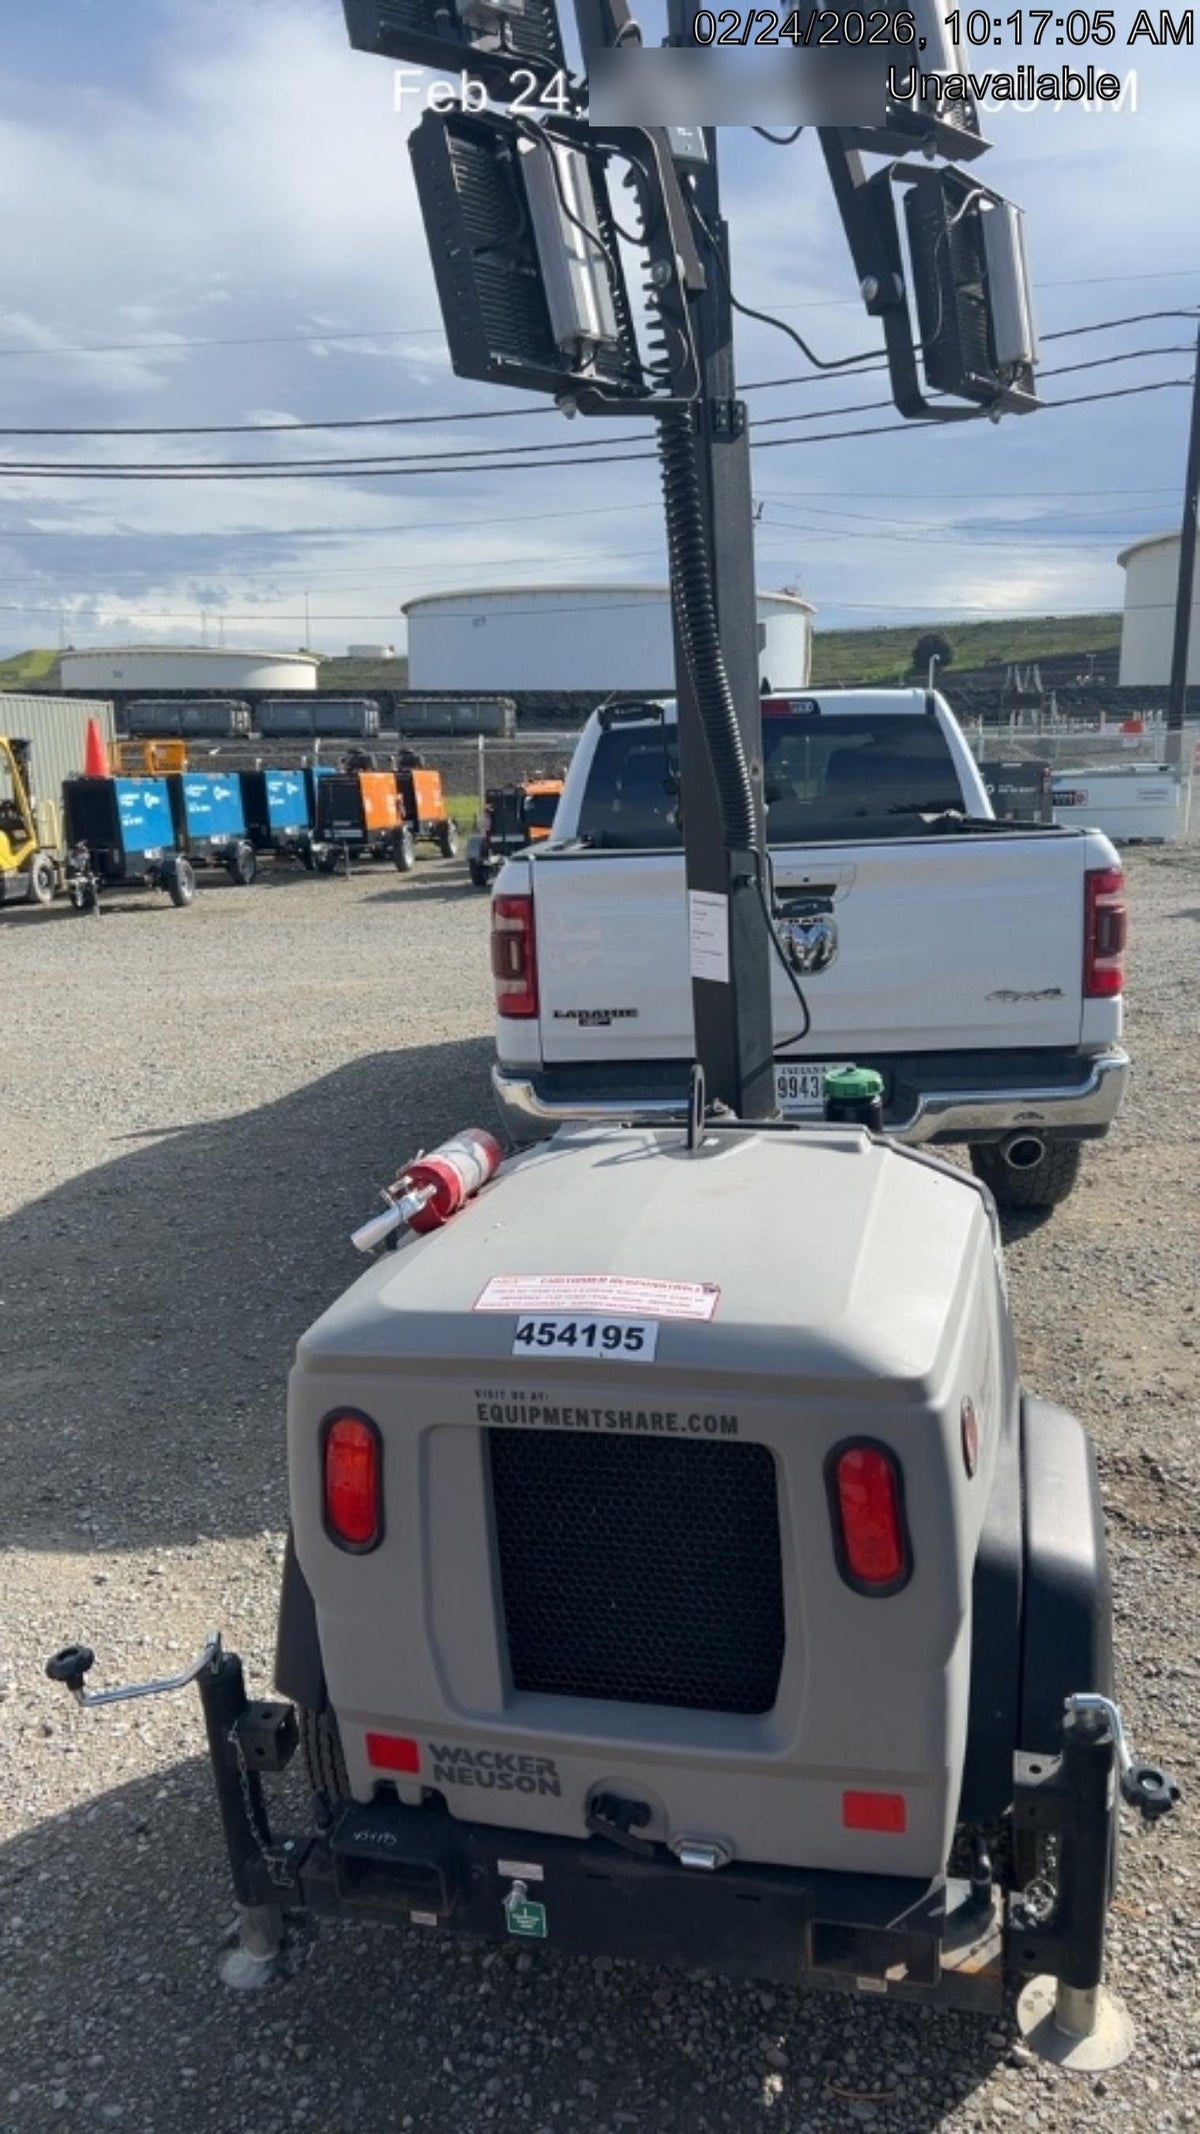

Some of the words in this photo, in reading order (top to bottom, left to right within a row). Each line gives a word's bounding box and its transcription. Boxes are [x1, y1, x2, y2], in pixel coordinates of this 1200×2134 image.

[777, 1076, 829, 1099] 9943
[515, 1321, 645, 1352] 454195
[474, 1389, 506, 1400] VISIT
[511, 1391, 526, 1401] US
[476, 1403, 739, 1435] EQUIPMENTSHARE.COM
[427, 1742, 558, 1778] WACKER
[432, 1763, 563, 1798] NEUSON
